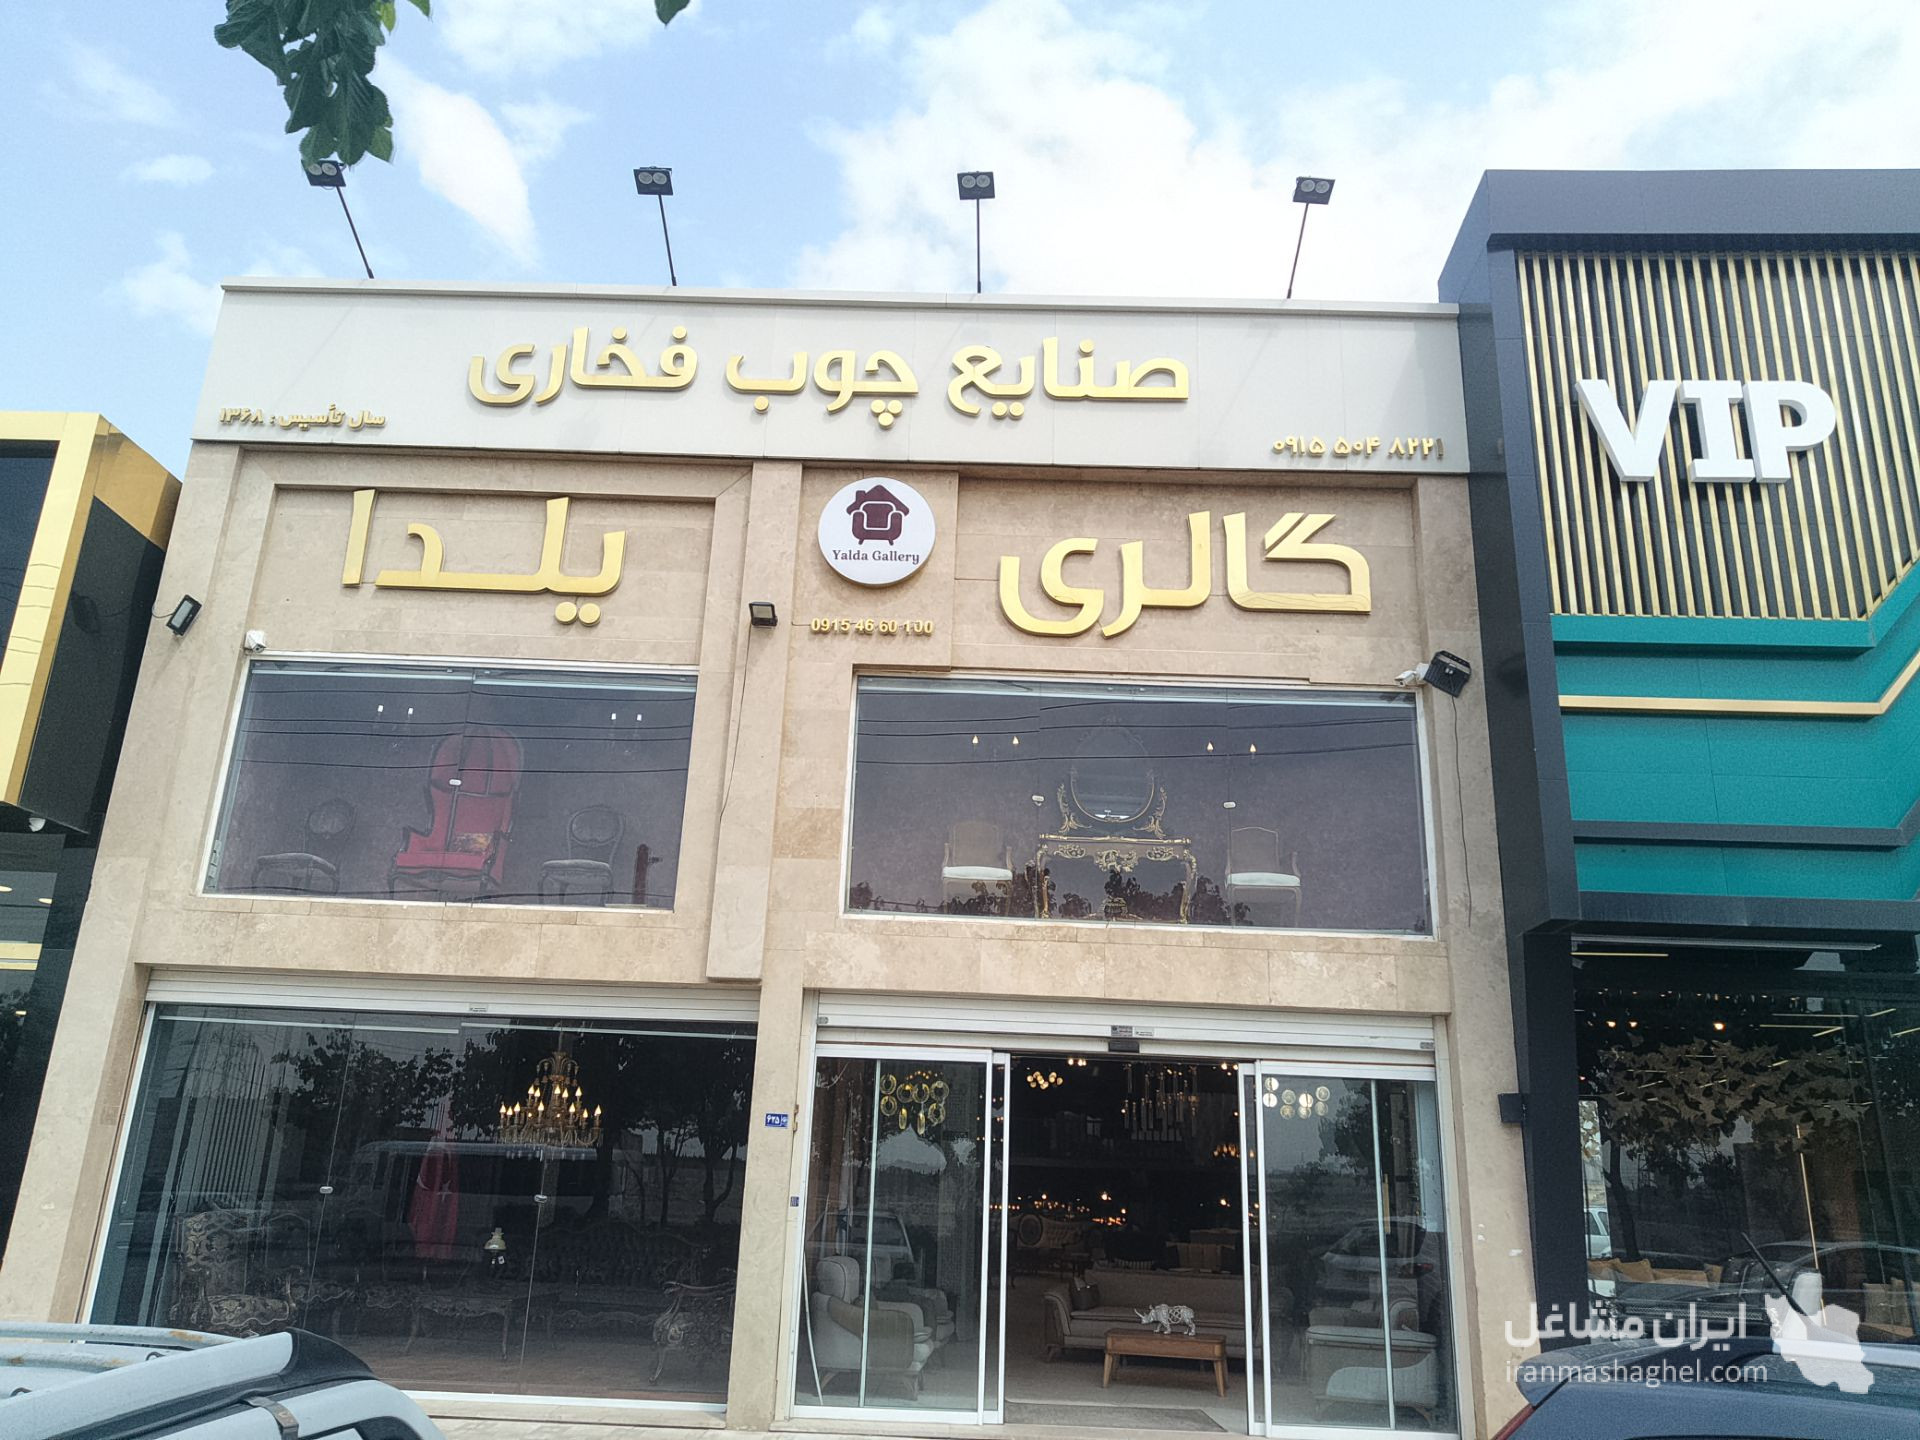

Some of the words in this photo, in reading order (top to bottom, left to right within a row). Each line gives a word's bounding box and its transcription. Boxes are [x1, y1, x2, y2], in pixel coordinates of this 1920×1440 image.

[468, 326, 698, 406] فخاری
[725, 349, 919, 429] چوب
[947, 336, 1189, 420] صنایع
[218, 407, 264, 425] ۱۳۶۸
[348, 408, 387, 430] سال
[1272, 435, 1326, 456] ۰۹۱۵
[1332, 436, 1382, 456] ۵۰۴
[1575, 379, 1837, 484] VIP
[342, 488, 628, 627] یلدا
[832, 549, 869, 561] Yalda
[871, 550, 921, 565] Gallery
[1000, 510, 1372, 640] گالری
[810, 618, 851, 634] 0915
[854, 619, 875, 635] 46
[878, 619, 899, 636] 60
